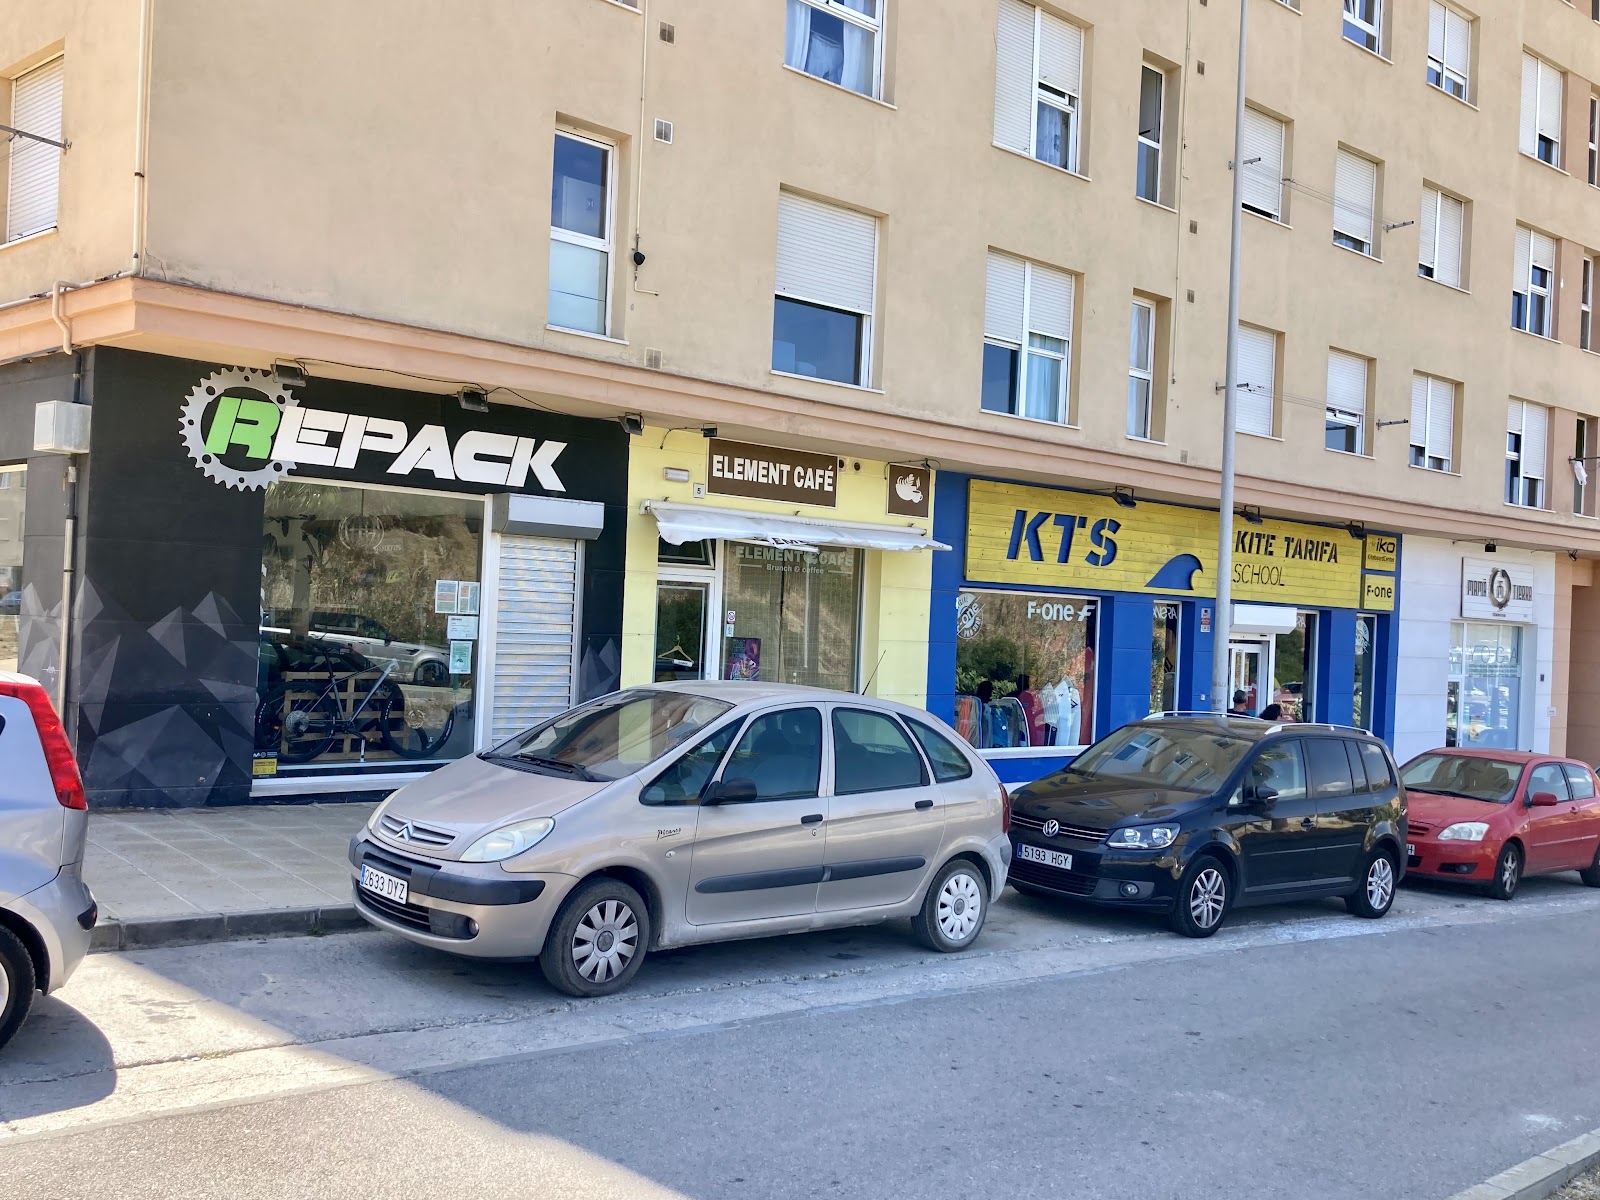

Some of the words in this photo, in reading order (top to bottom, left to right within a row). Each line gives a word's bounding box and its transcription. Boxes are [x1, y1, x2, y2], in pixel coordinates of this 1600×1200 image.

[204, 396, 567, 492] REPACK
[712, 454, 791, 486] ELEMENT
[793, 465, 834, 492] CAFÉ
[735, 545, 803, 563] ELEMENT
[1006, 509, 1121, 567] KTS
[1235, 530, 1277, 556] KITE
[1284, 536, 1338, 563] TARIFA
[766, 563, 793, 572] Brunch
[801, 566, 825, 575] coffee
[1232, 563, 1285, 587] SCHOOL
[1024, 846, 1046, 862] 5193
[1051, 852, 1069, 867] HGY
[364, 869, 385, 892] 2633
[387, 878, 406, 901] DYZ
